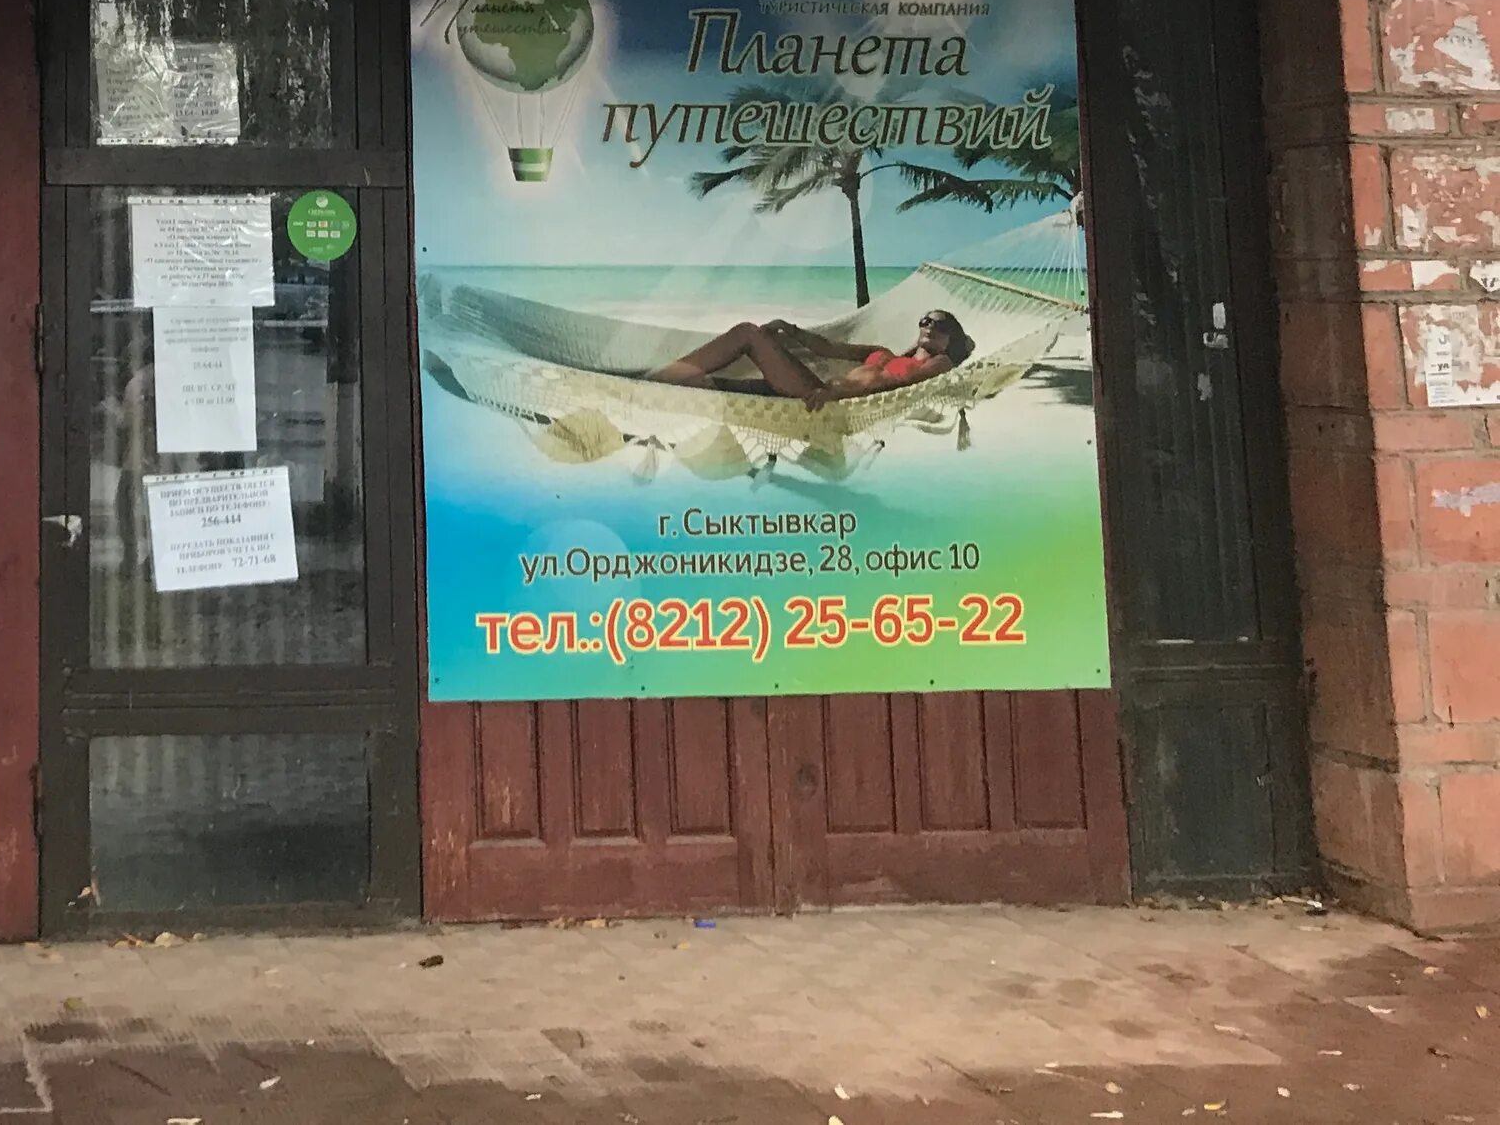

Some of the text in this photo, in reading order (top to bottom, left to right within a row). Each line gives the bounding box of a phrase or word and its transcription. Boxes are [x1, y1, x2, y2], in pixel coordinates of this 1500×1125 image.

[758, 0, 991, 17] ТУРИСТИЧЕСКАЯ КОМПАНИЯ
[686, 7, 971, 77] Планета
[601, 83, 1056, 169] путешествий
[659, 507, 858, 541] г. Сыктывкар
[232, 554, 277, 567] 72-71-68
[520, 542, 980, 583] ул.Орджоникидзе, 28, офис 10
[783, 594, 1027, 649] 25-65-22
